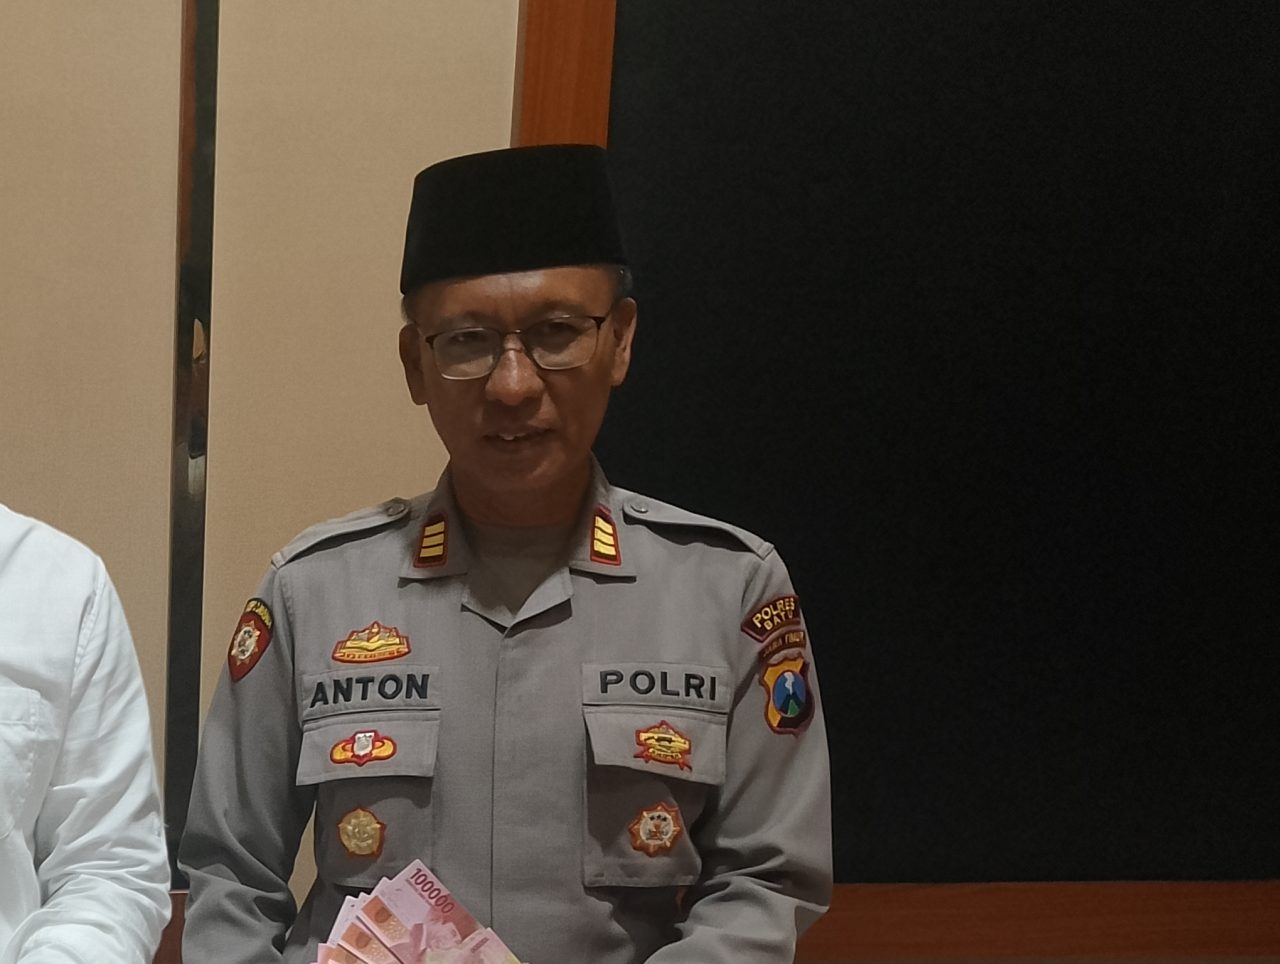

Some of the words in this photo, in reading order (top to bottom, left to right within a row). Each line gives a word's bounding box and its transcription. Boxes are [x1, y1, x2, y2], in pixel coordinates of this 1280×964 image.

[752, 597, 795, 629] POLRES
[763, 609, 793, 631] BATU
[309, 673, 430, 709] ANTON
[599, 669, 717, 701] POLRI
[409, 867, 455, 914] 100000
